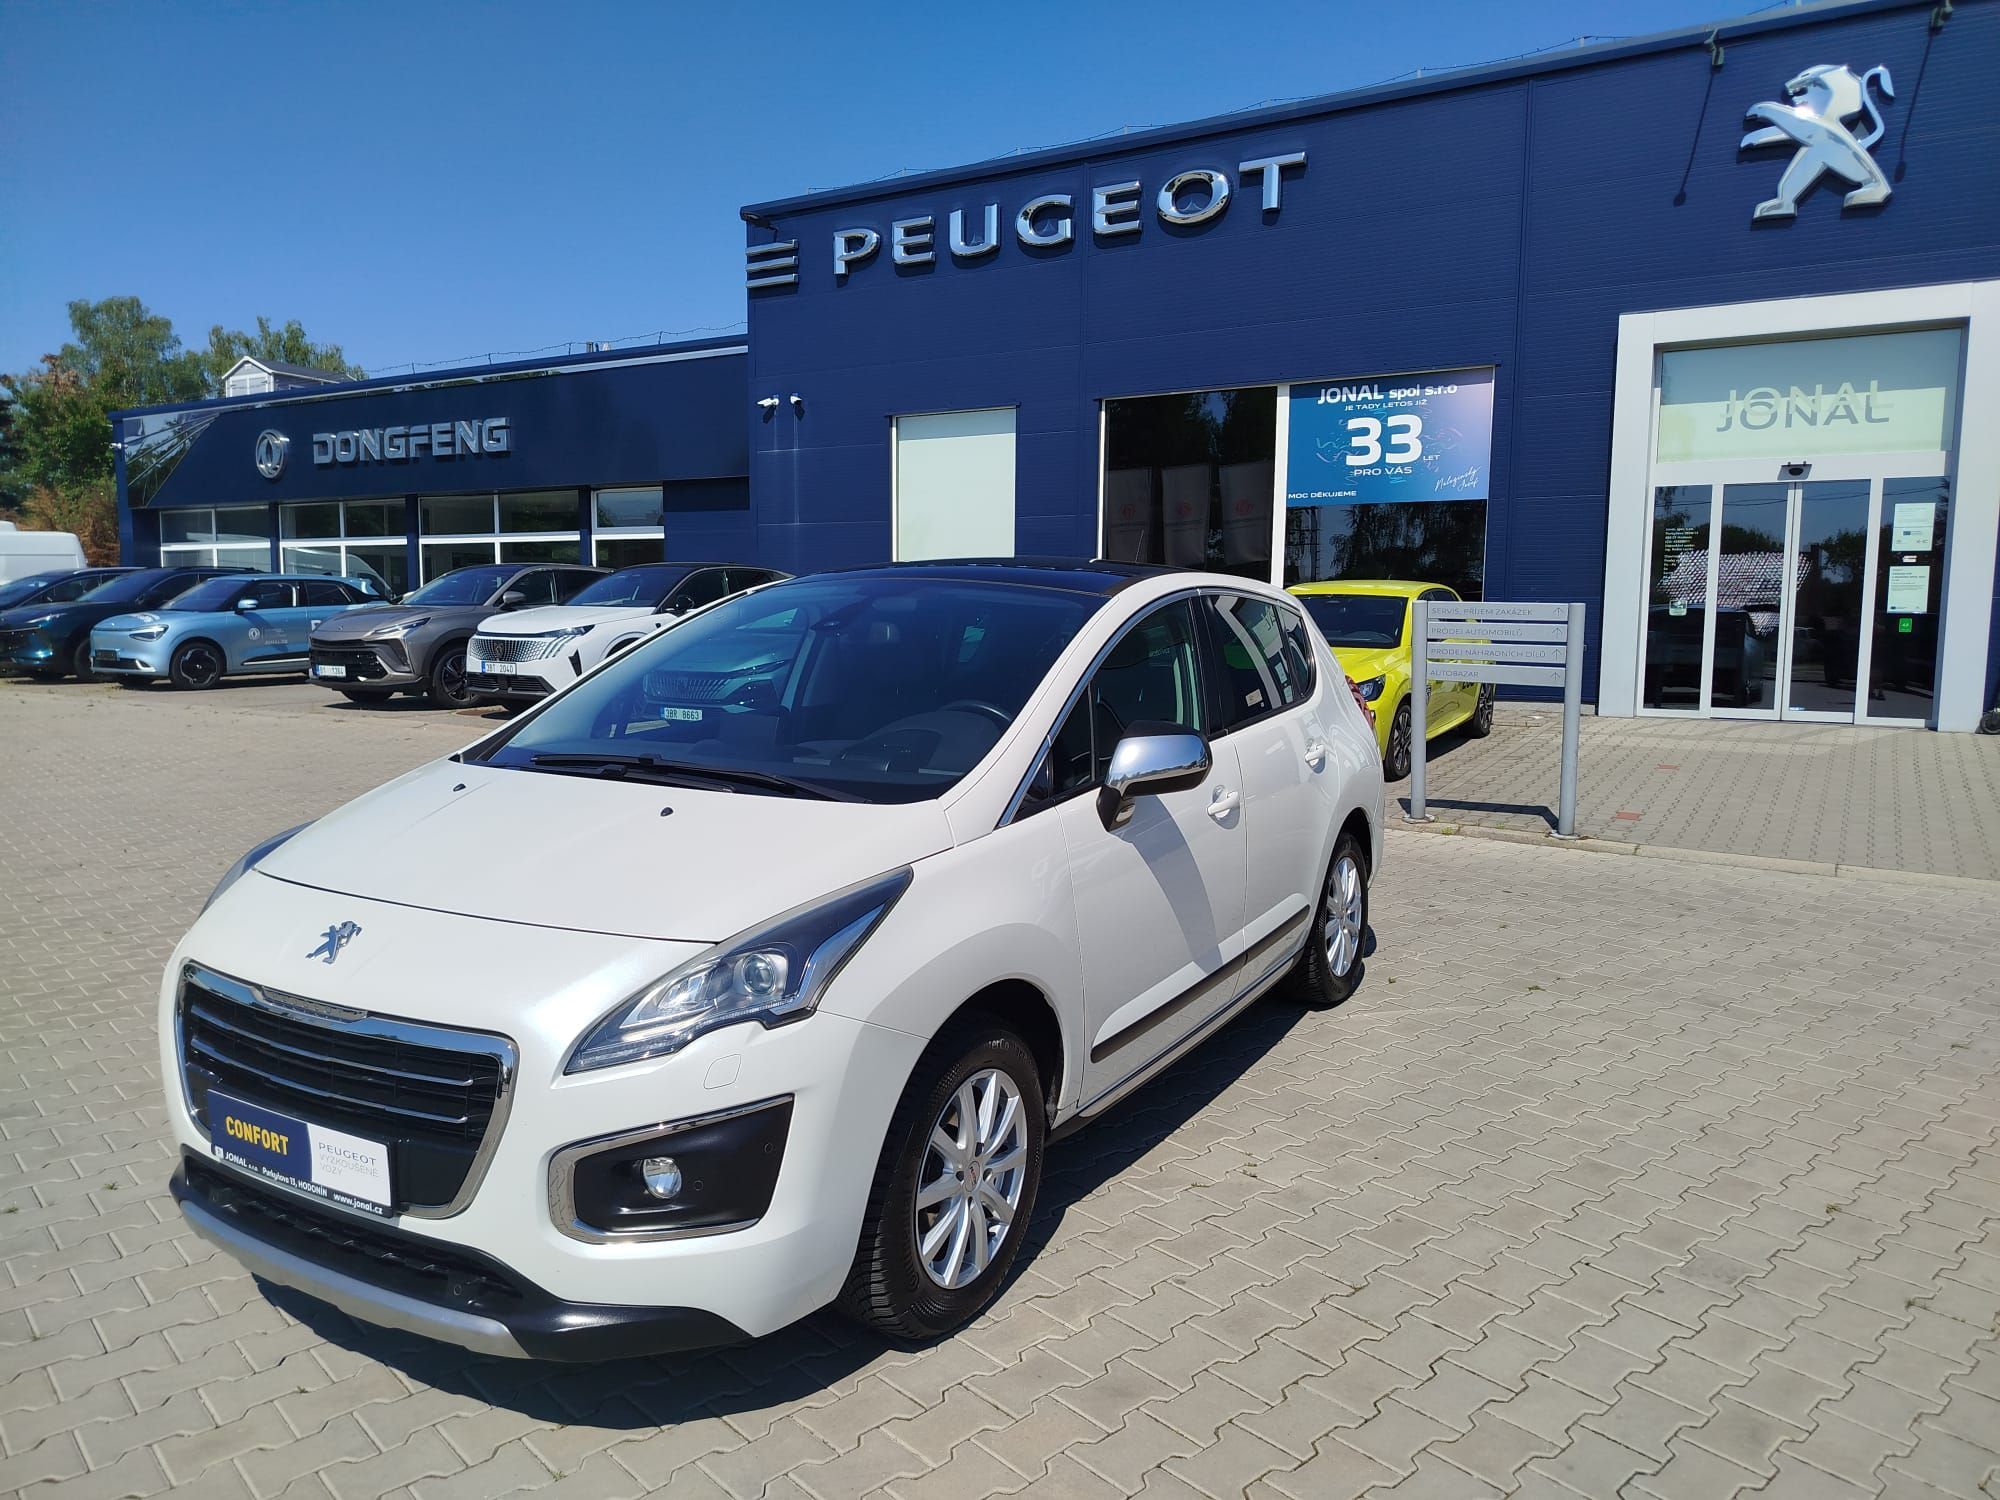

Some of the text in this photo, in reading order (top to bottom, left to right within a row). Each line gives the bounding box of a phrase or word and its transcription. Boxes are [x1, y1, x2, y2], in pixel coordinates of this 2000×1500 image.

[834, 152, 1307, 275] PEUGEOT
[1317, 384, 1384, 405] JONAL
[1389, 384, 1420, 400] spol
[1718, 380, 1894, 424] JONAL
[1356, 403, 1380, 411] TADY
[1383, 401, 1413, 409] LETOS
[313, 417, 510, 464] DONGFENG
[1346, 414, 1422, 466] 33
[1354, 465, 1413, 477] PRO VÁS
[1310, 490, 1357, 498] DĚKUJEME
[1430, 669, 1479, 678] AUTOBAZAR
[665, 709, 699, 720] 3BR 8663
[225, 1116, 289, 1156] CONFORT
[318, 1142, 377, 1166] PEUGEOT
[320, 1163, 343, 1176] VOZY
[225, 1151, 248, 1168] JONAL
[298, 1180, 328, 1197] HODONÍN
[333, 1193, 383, 1214] www.jonal.cz
